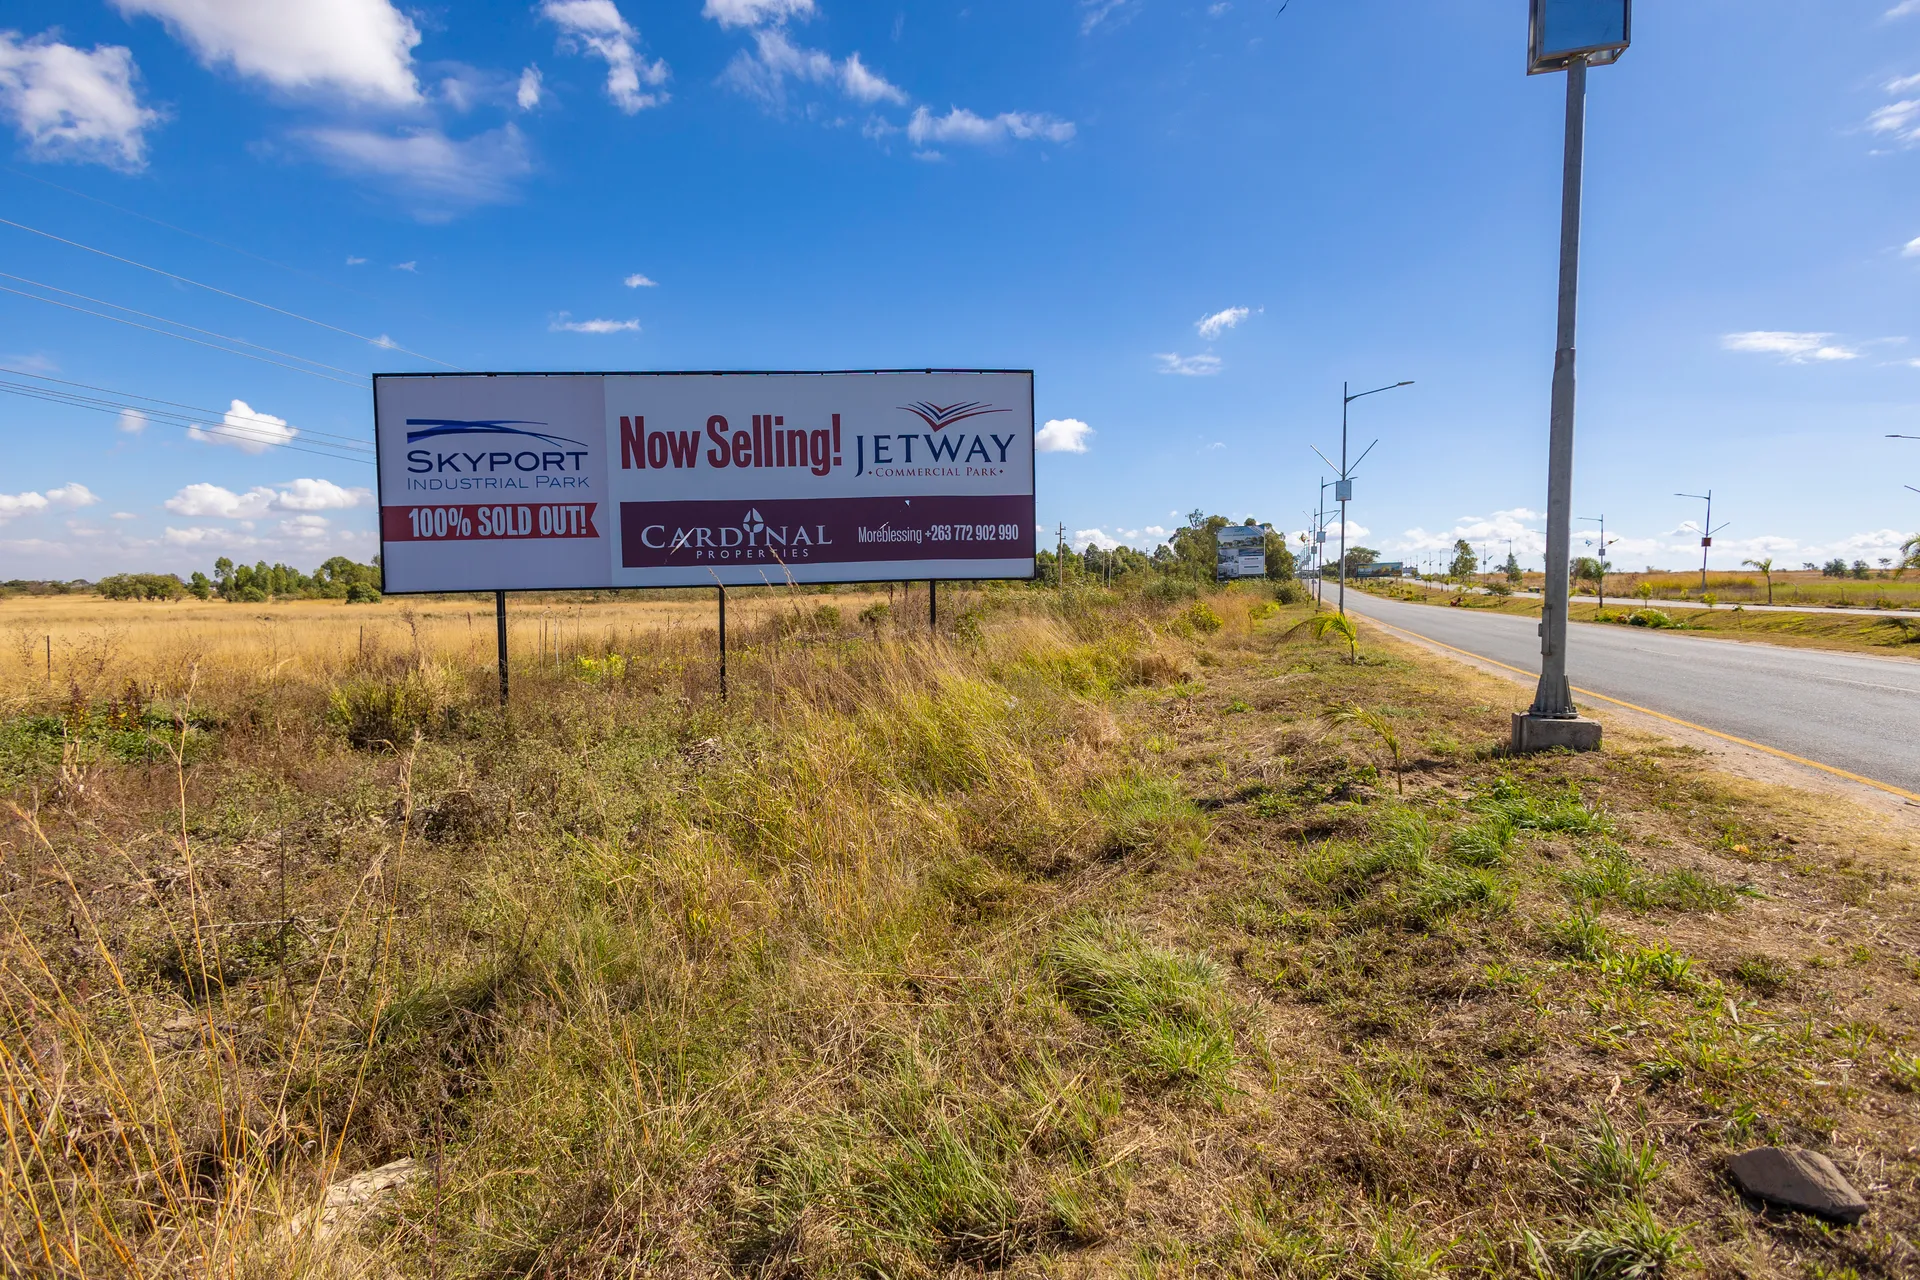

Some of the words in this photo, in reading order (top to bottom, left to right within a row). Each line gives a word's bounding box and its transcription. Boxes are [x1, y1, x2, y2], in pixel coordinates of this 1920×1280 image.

[619, 415, 701, 469] Now
[706, 413, 842, 477] Selling!
[854, 433, 1016, 477] JETWAY
[407, 450, 588, 474] SKYPORT
[875, 467, 960, 477] COMMERCIAL
[966, 466, 997, 476] PARK
[407, 477, 529, 490] INDUSTRIAL
[535, 475, 590, 489] PARK
[408, 507, 471, 538] 100%
[477, 506, 532, 536] SOLD
[539, 505, 587, 535] OUT!
[858, 526, 922, 544] Moreblessing
[925, 525, 952, 541] +263
[954, 524, 973, 541] 772
[975, 524, 996, 541] 902
[998, 523, 1019, 540] 990
[641, 524, 833, 549] CARDINAL
[696, 548, 809, 559] PROPERTIES
